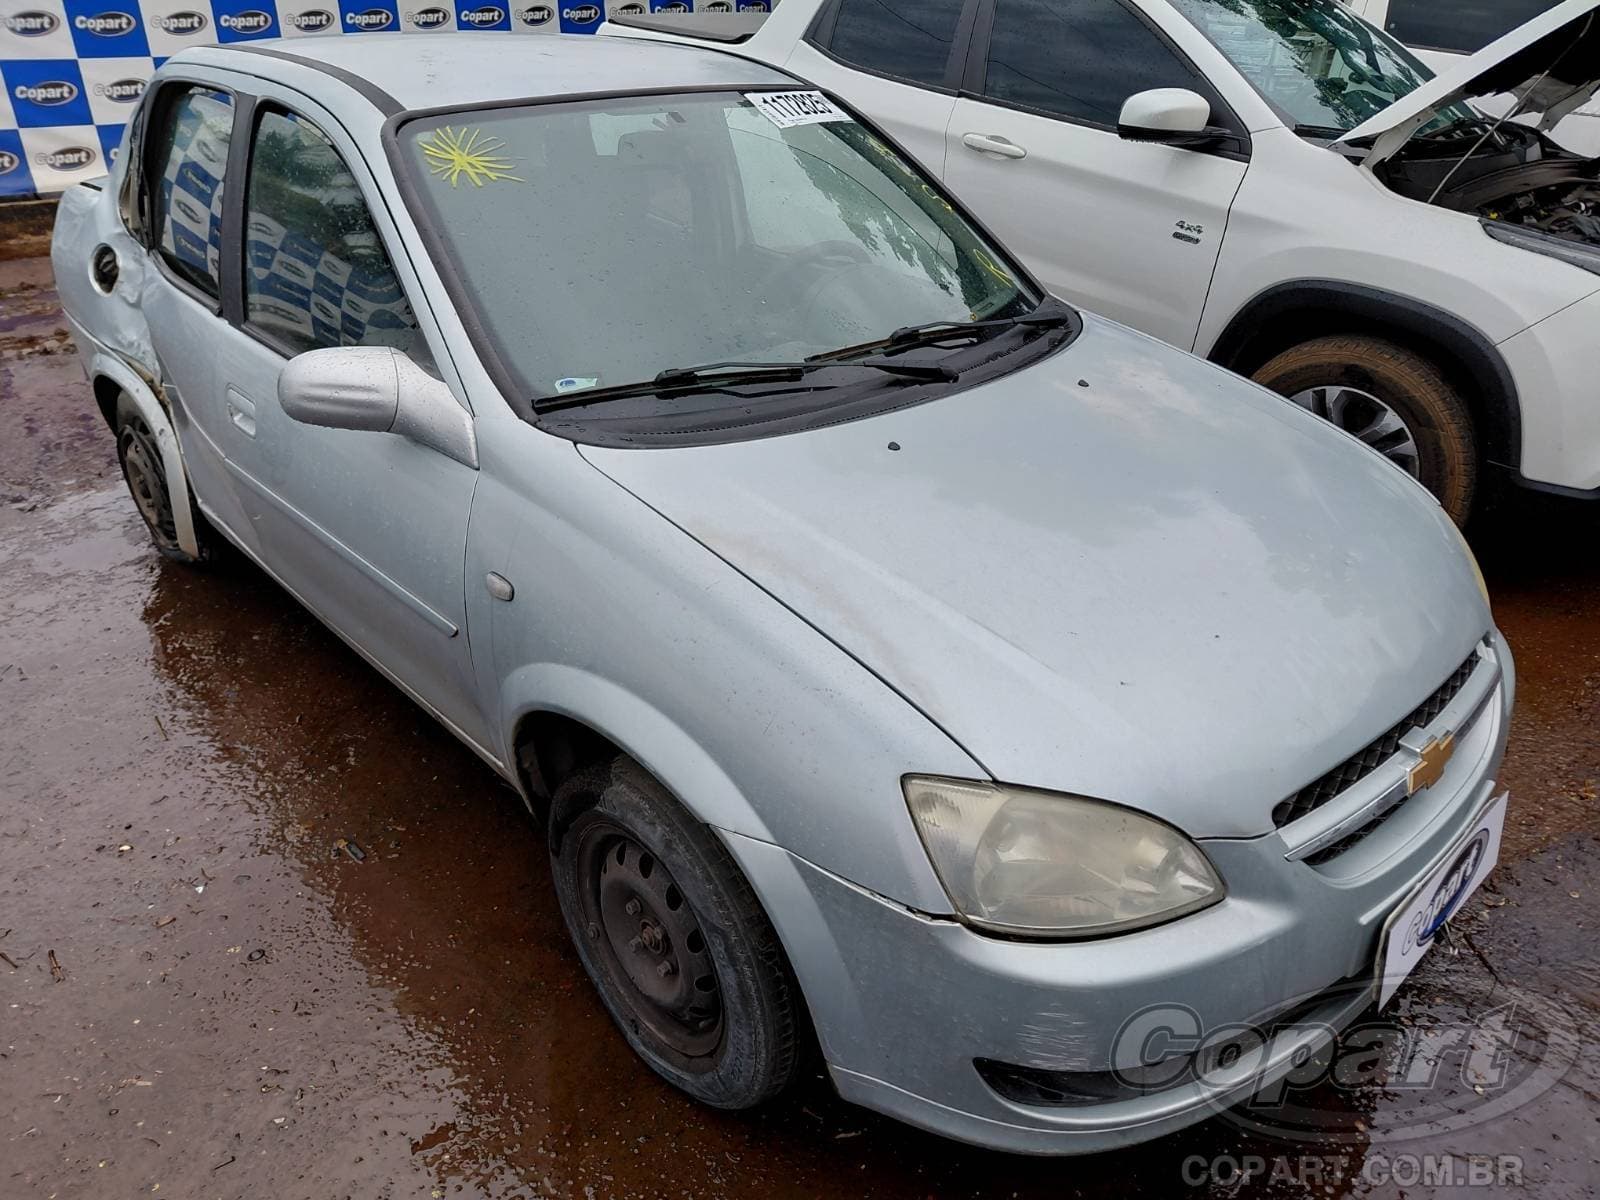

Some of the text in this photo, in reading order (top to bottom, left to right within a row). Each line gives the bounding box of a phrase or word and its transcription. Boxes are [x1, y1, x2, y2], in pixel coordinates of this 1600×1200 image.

[220, 14, 266, 29] Copart
[285, 13, 328, 28] Copart
[345, 12, 388, 27] Copart
[406, 11, 444, 25] Copart
[460, 10, 499, 23] Copart
[515, 9, 548, 21] Copart
[562, 8, 596, 20] Copart
[75, 15, 129, 32] Copart
[150, 14, 200, 31] Copart
[15, 85, 71, 102] Copart
[94, 83, 144, 98] Copart
[35, 150, 88, 167] Copart
[1402, 837, 1480, 956] Copart
